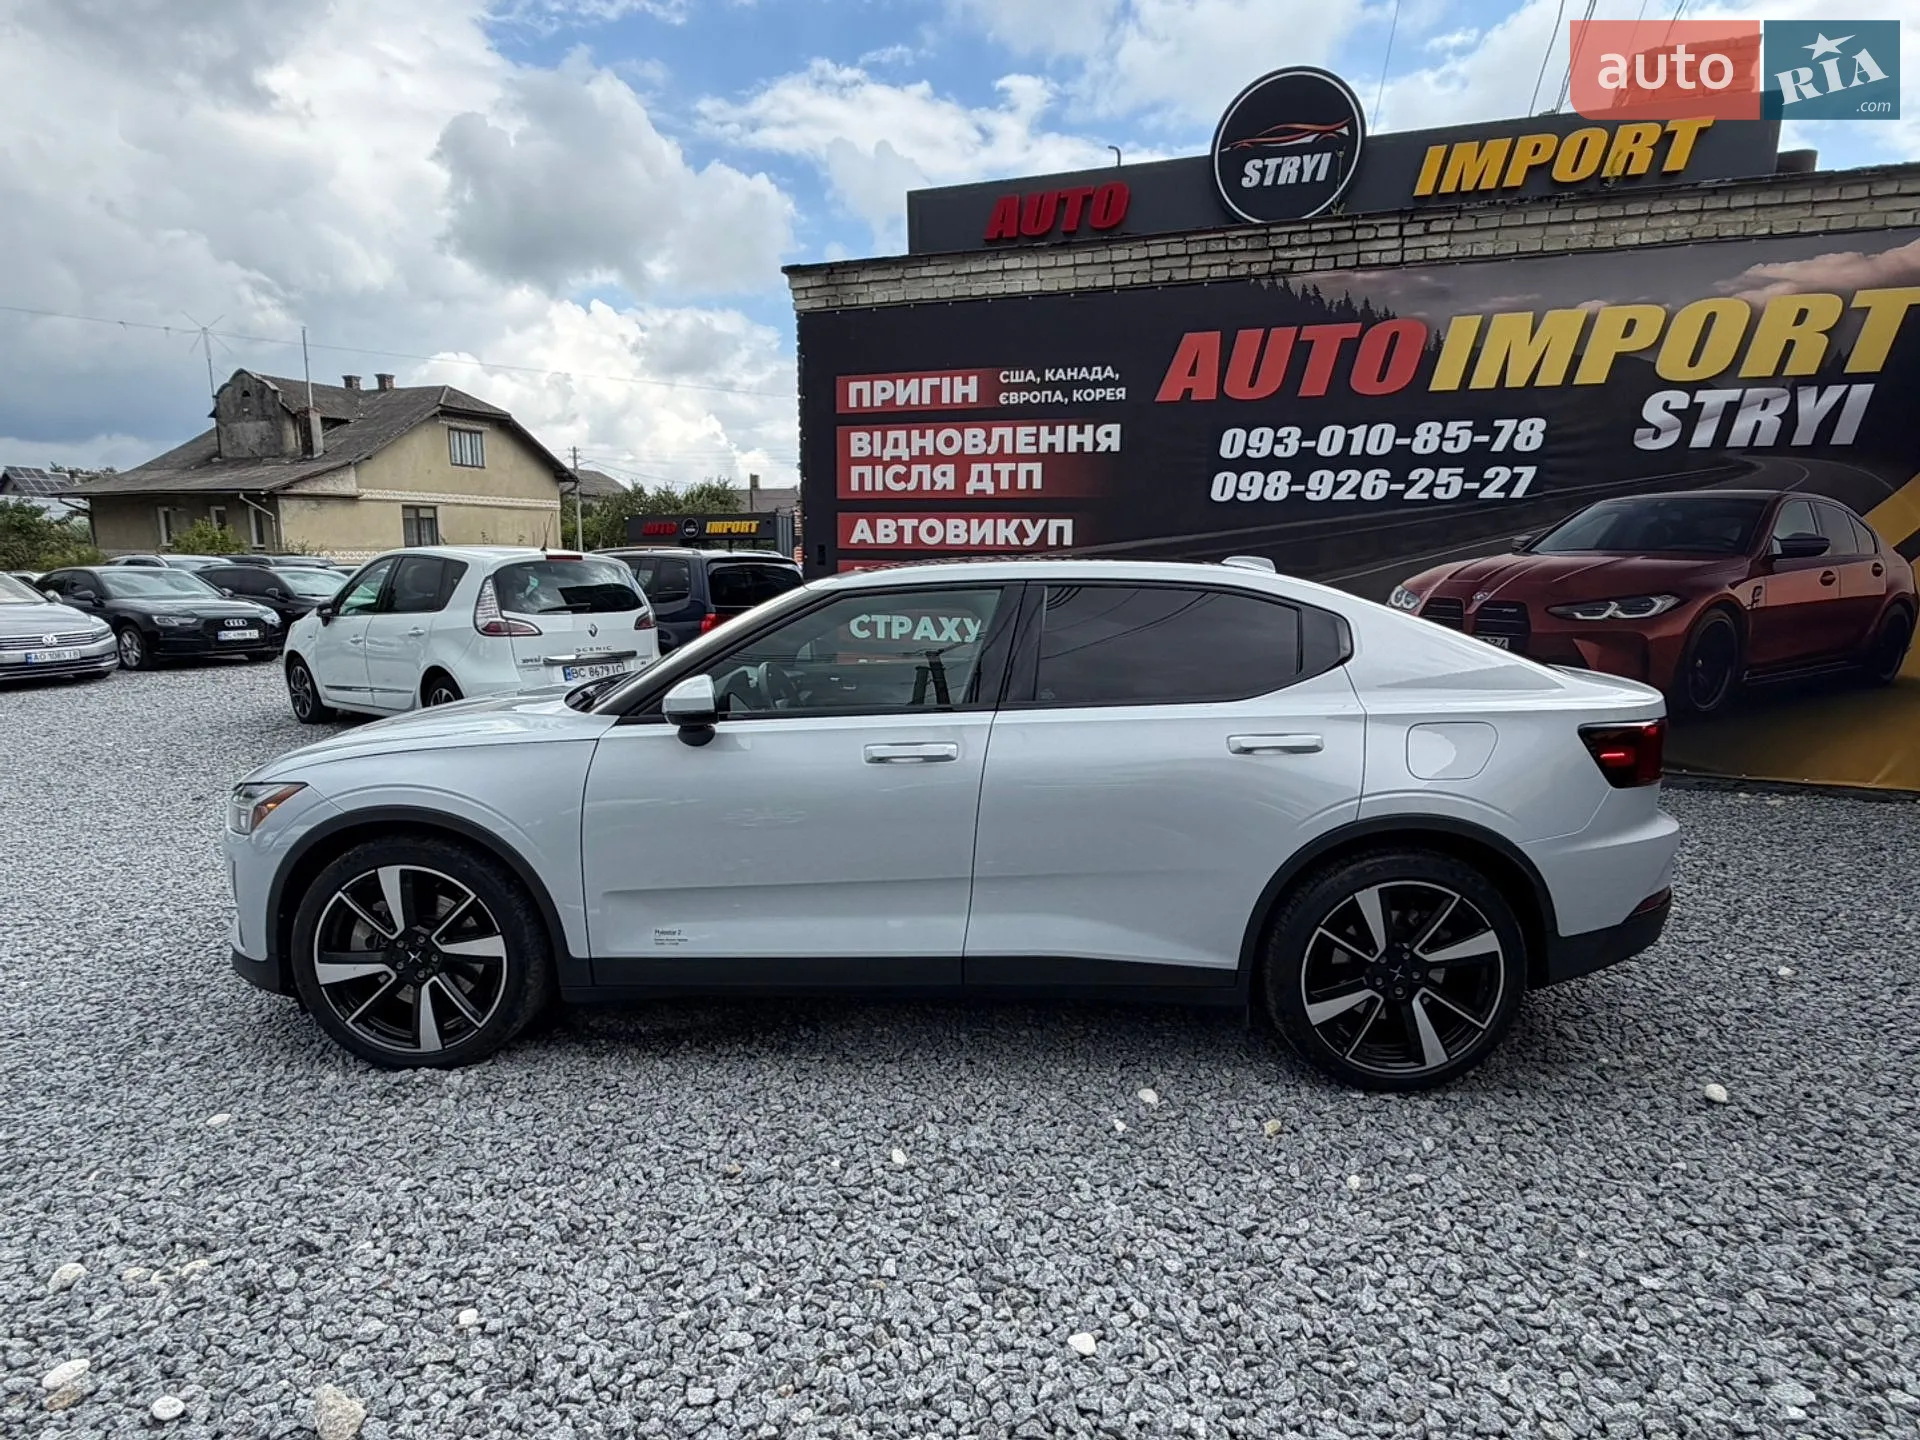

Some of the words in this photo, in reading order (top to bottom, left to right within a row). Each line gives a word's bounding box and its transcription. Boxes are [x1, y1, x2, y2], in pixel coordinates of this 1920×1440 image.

[1241, 152, 1333, 189] STRYI
[1412, 116, 1716, 197] IMPORT
[983, 181, 1130, 241] AUTO
[848, 375, 978, 408] ПРИГІН
[999, 369, 1041, 385] США,
[1045, 366, 1120, 382] КАНАДА,
[999, 388, 1069, 405] ЄВРОПА,
[1072, 386, 1127, 403] КОРЕЯ
[1633, 384, 1876, 450] STRYI
[849, 423, 1122, 461] ВІДНОВЛЕННЯ
[1219, 417, 1548, 459] 093-010-85-78
[850, 464, 955, 492] ПІСЛЯ
[965, 462, 1043, 495] ДТП
[1210, 466, 1537, 502] 098-926-25-27
[642, 520, 678, 536] AUTO
[705, 520, 760, 535] IMPORT
[849, 518, 1074, 547] АВТОВИКУП
[571, 667, 586, 679] BC
